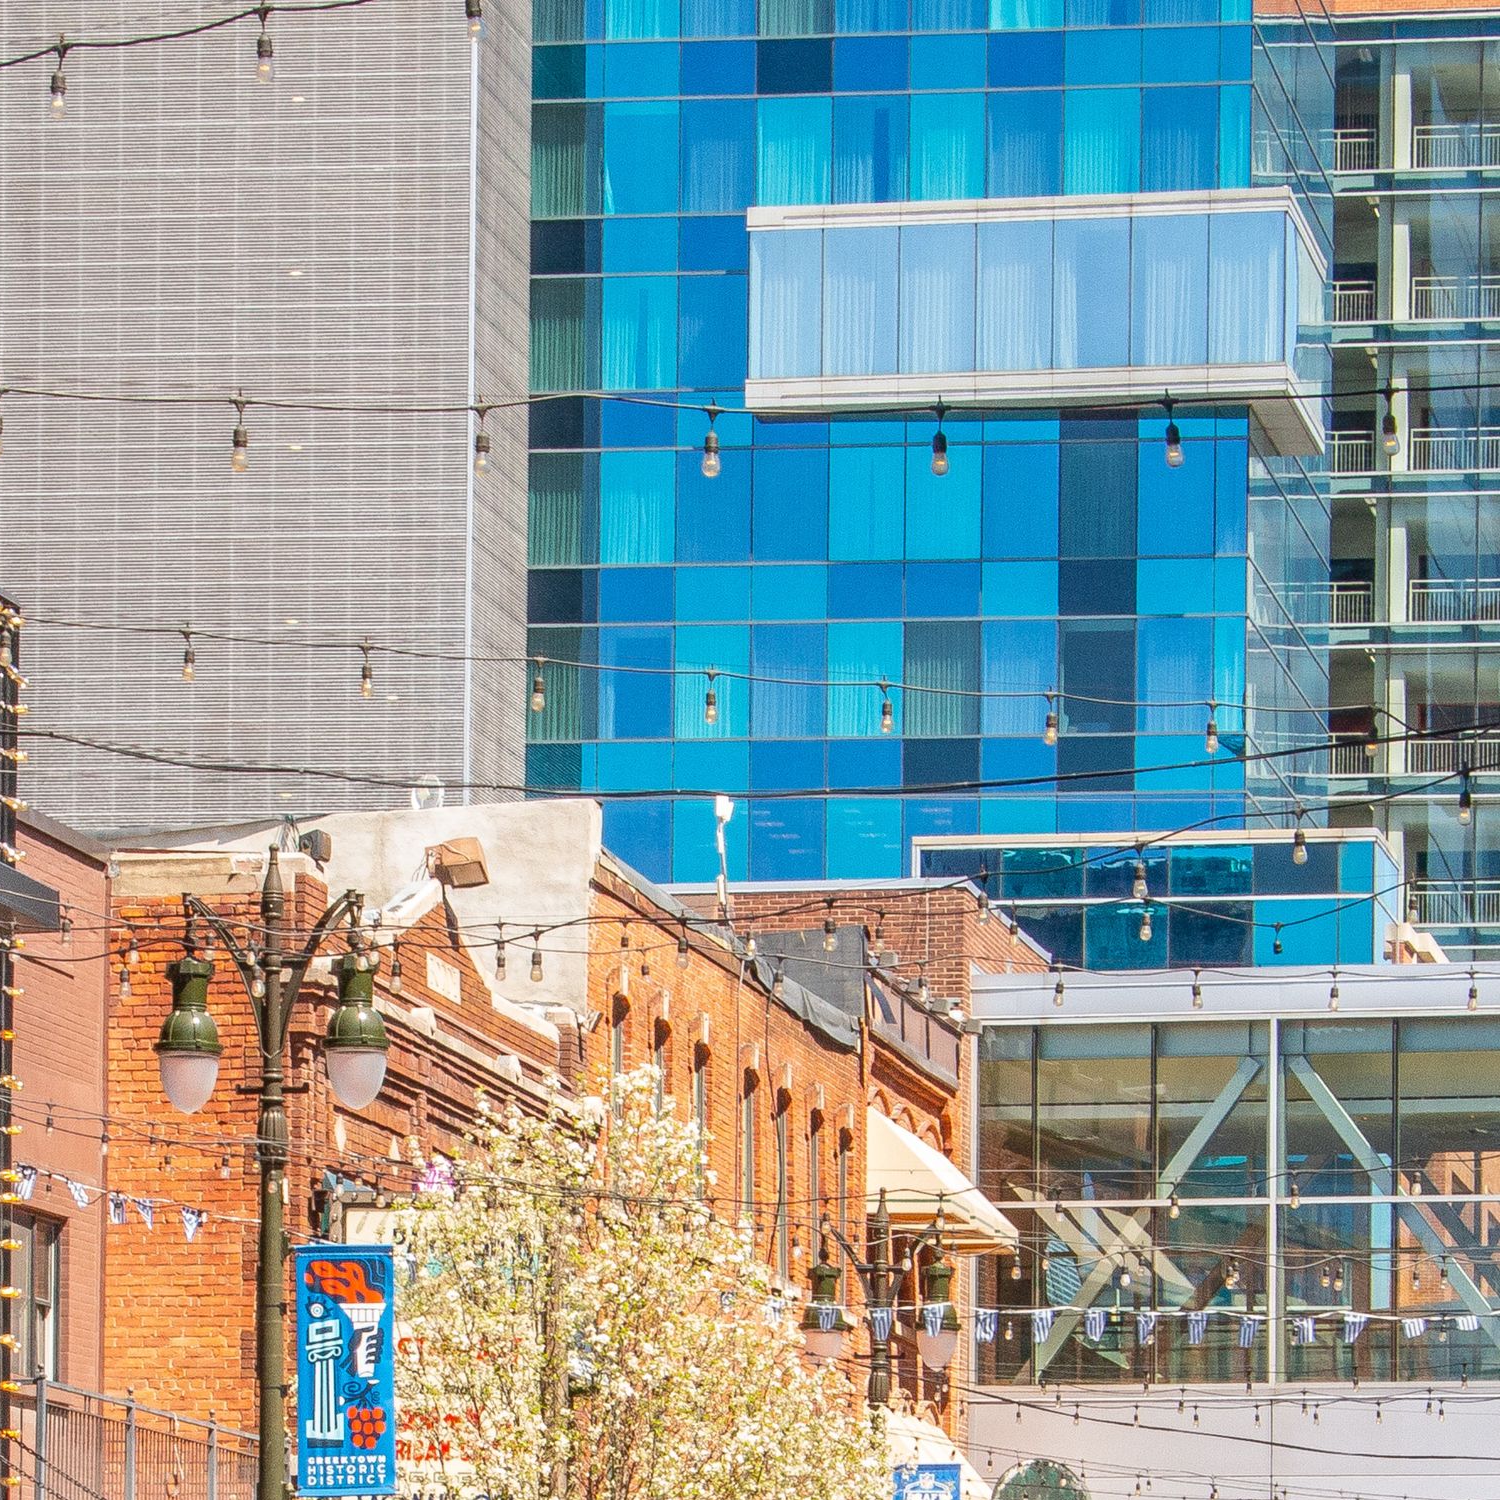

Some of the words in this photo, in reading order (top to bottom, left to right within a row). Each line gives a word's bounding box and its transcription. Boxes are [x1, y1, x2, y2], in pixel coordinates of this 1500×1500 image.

[307, 1454, 387, 1465] GREEKTOWN
[307, 1464, 387, 1475] HISTORIC
[307, 1474, 387, 1486] DISTRICT
